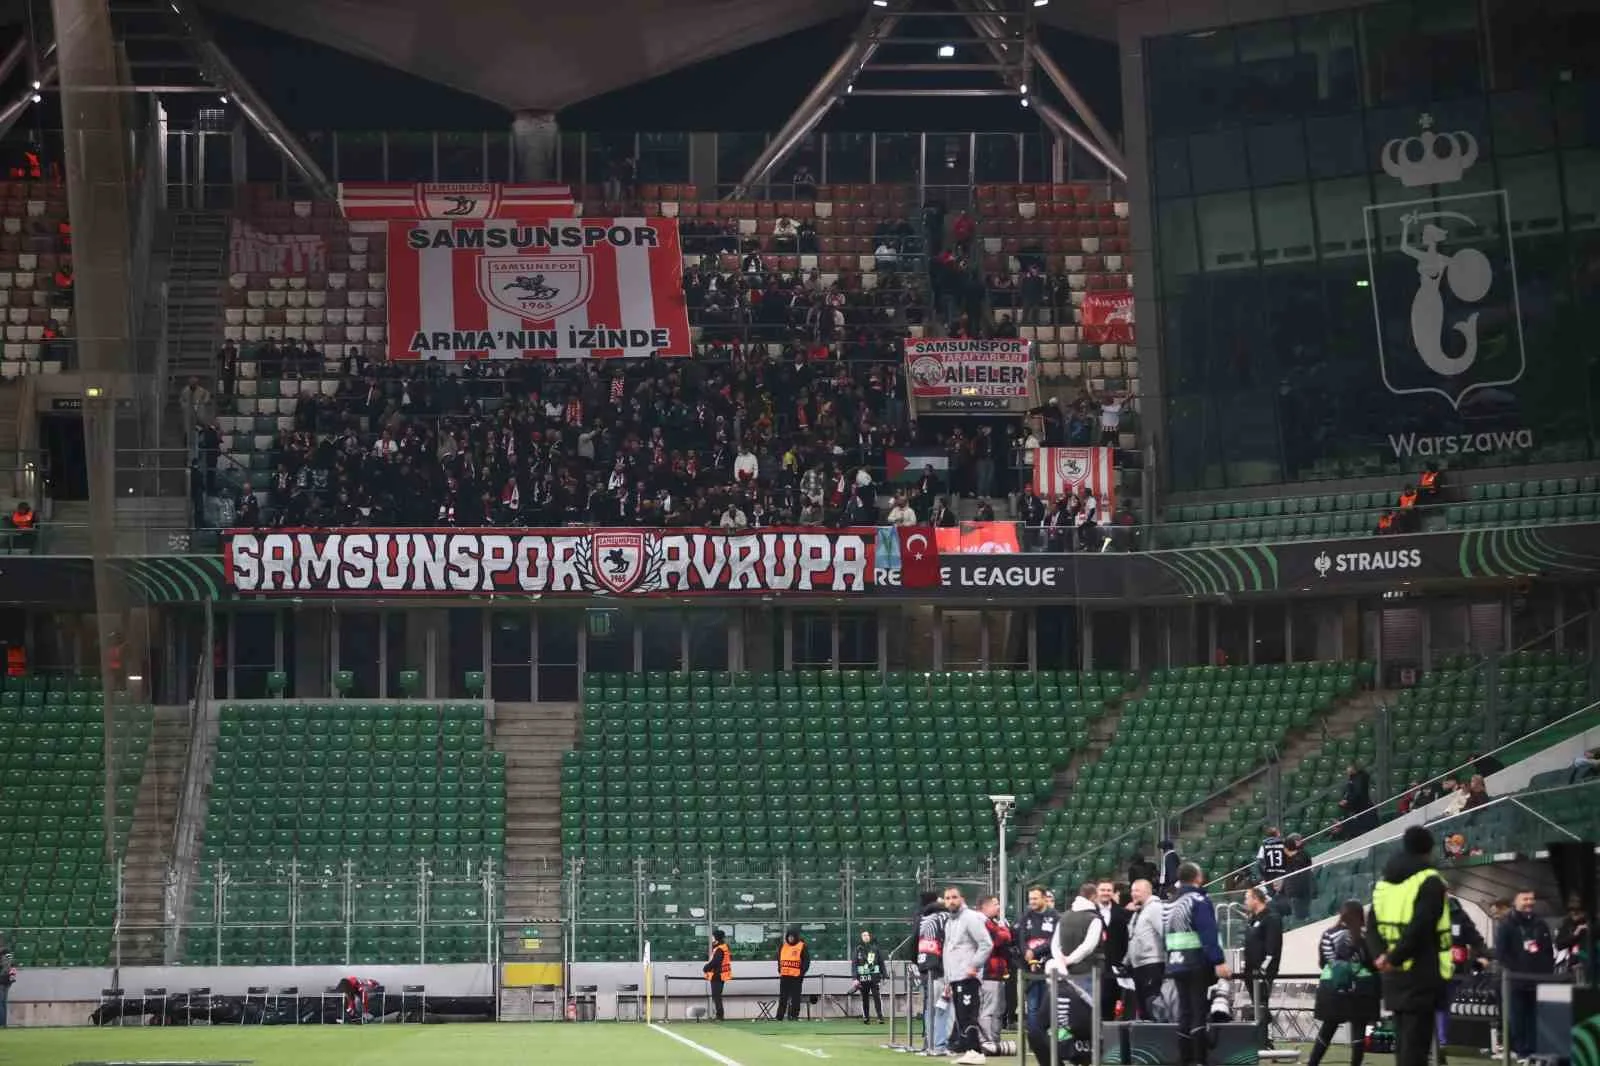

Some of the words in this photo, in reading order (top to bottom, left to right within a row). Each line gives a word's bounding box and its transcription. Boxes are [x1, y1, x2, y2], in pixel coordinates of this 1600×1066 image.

[409, 227, 657, 249] SAMSUNSPOR
[411, 331, 558, 350] ARMA'NIN
[569, 326, 669, 348] İZİNDE
[916, 342, 1020, 352] SAMSUNSPOR
[945, 362, 1024, 383] AİLELER
[1389, 429, 1533, 456] Warszawa
[232, 534, 583, 591] SAMSUNSPOR
[660, 533, 866, 591] AVRUPA
[1336, 549, 1421, 572] STRAUSS
[1267, 850, 1282, 867] 13
